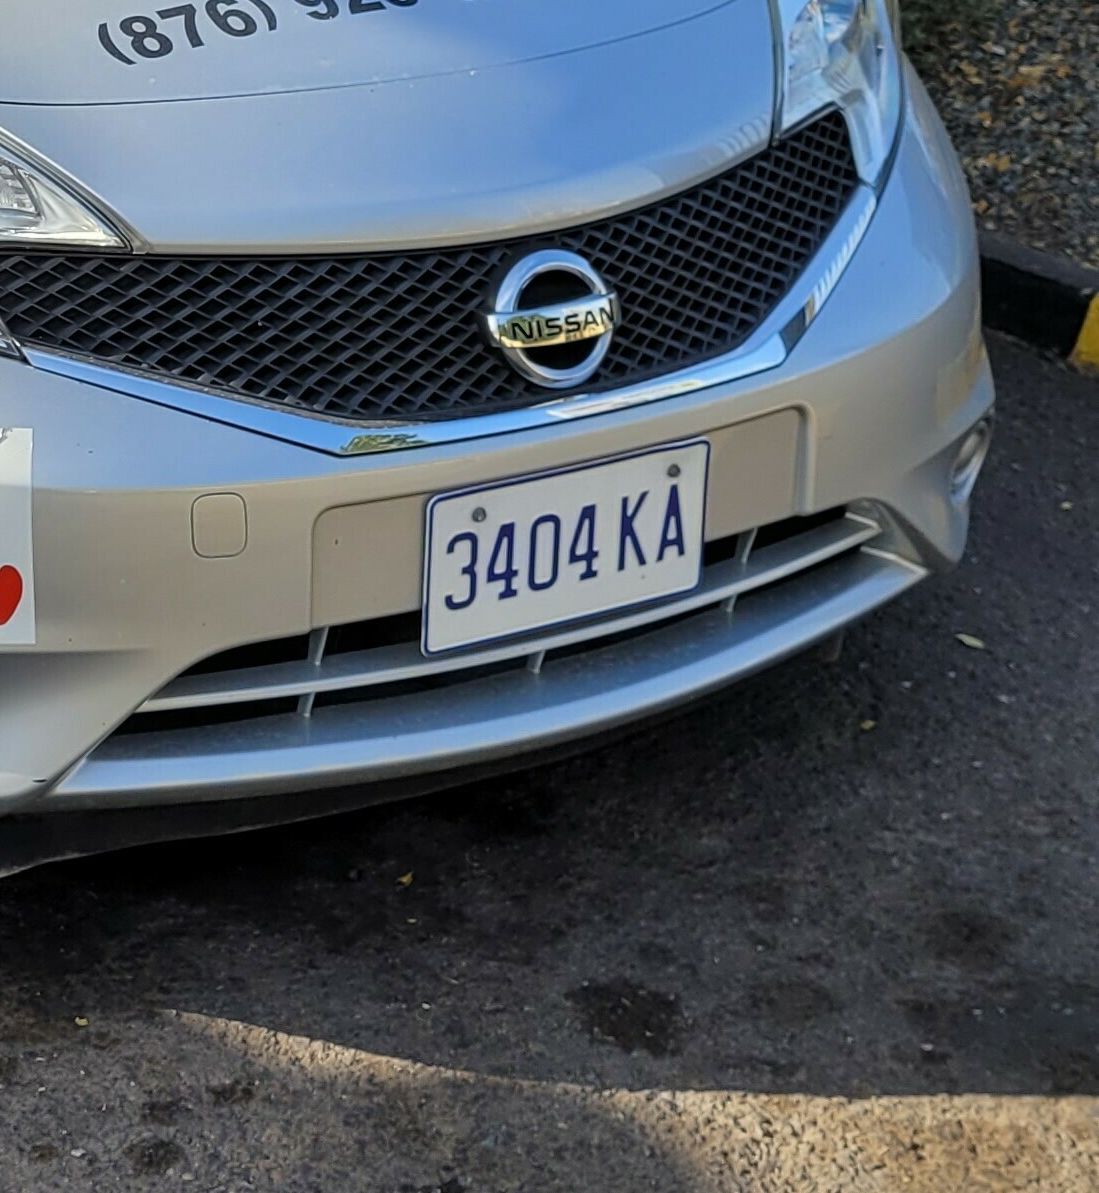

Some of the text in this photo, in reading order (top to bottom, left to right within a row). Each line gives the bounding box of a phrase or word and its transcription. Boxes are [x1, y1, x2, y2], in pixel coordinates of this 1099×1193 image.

[508, 300, 616, 341] NISSAN
[444, 484, 686, 611] 3404 KA
